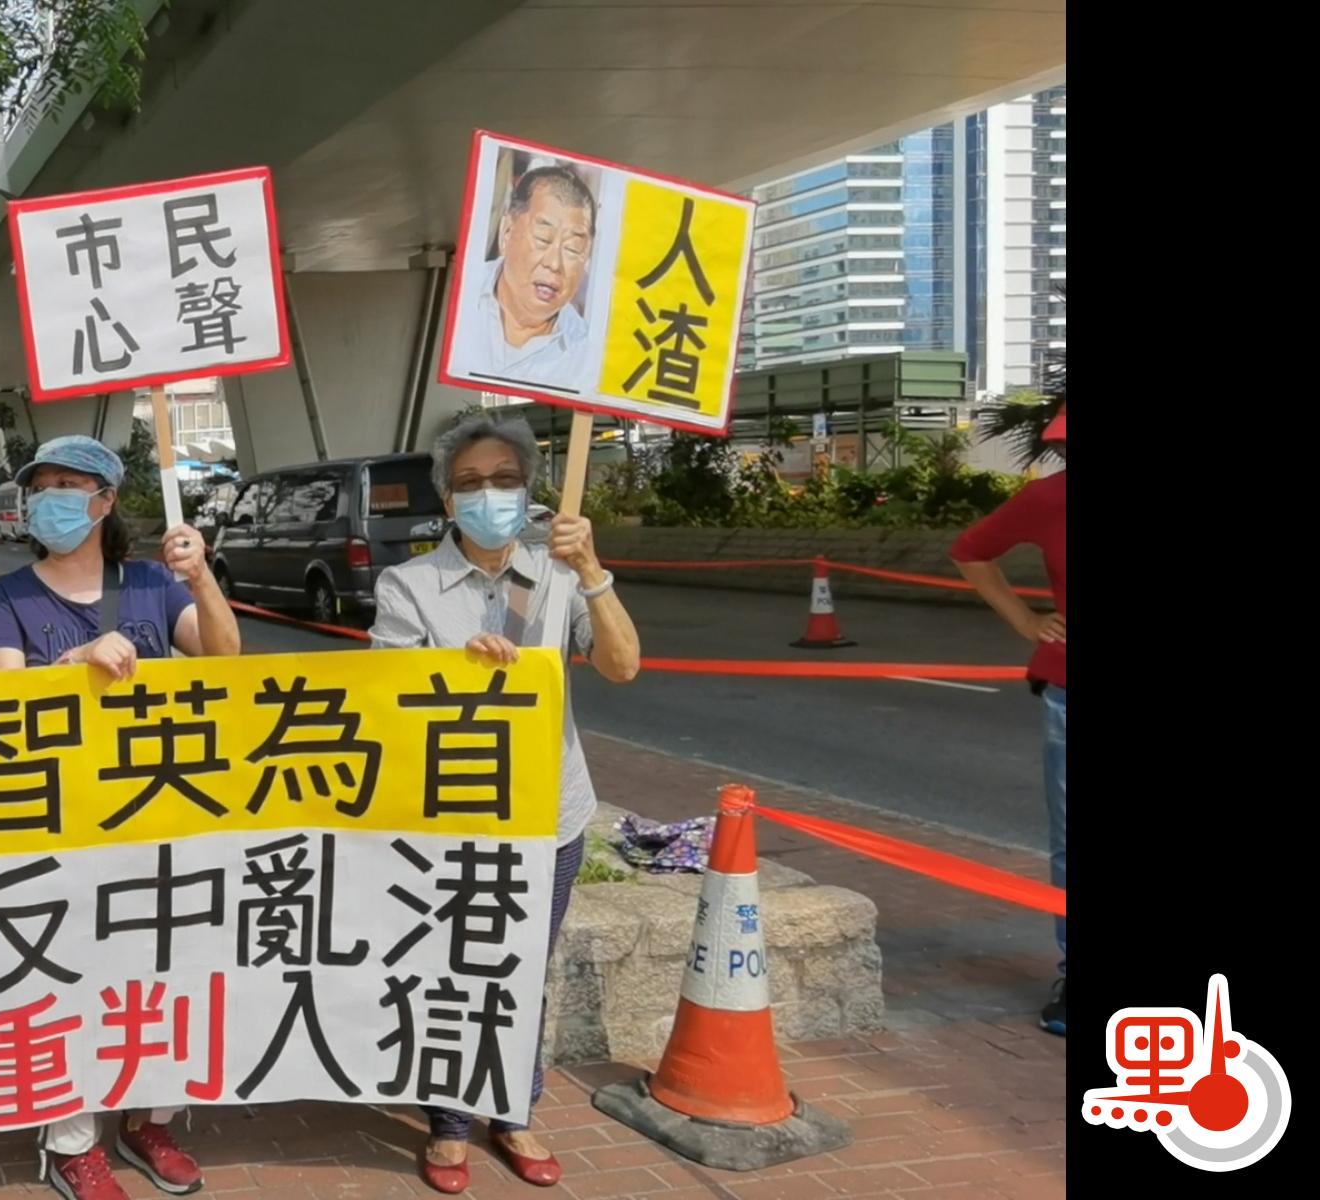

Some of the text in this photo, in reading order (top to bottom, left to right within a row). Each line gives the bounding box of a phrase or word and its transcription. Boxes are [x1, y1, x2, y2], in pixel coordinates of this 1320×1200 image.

[56, 214, 140, 375] 市心
[162, 193, 247, 355] 民聲
[621, 197, 716, 411] 人渣
